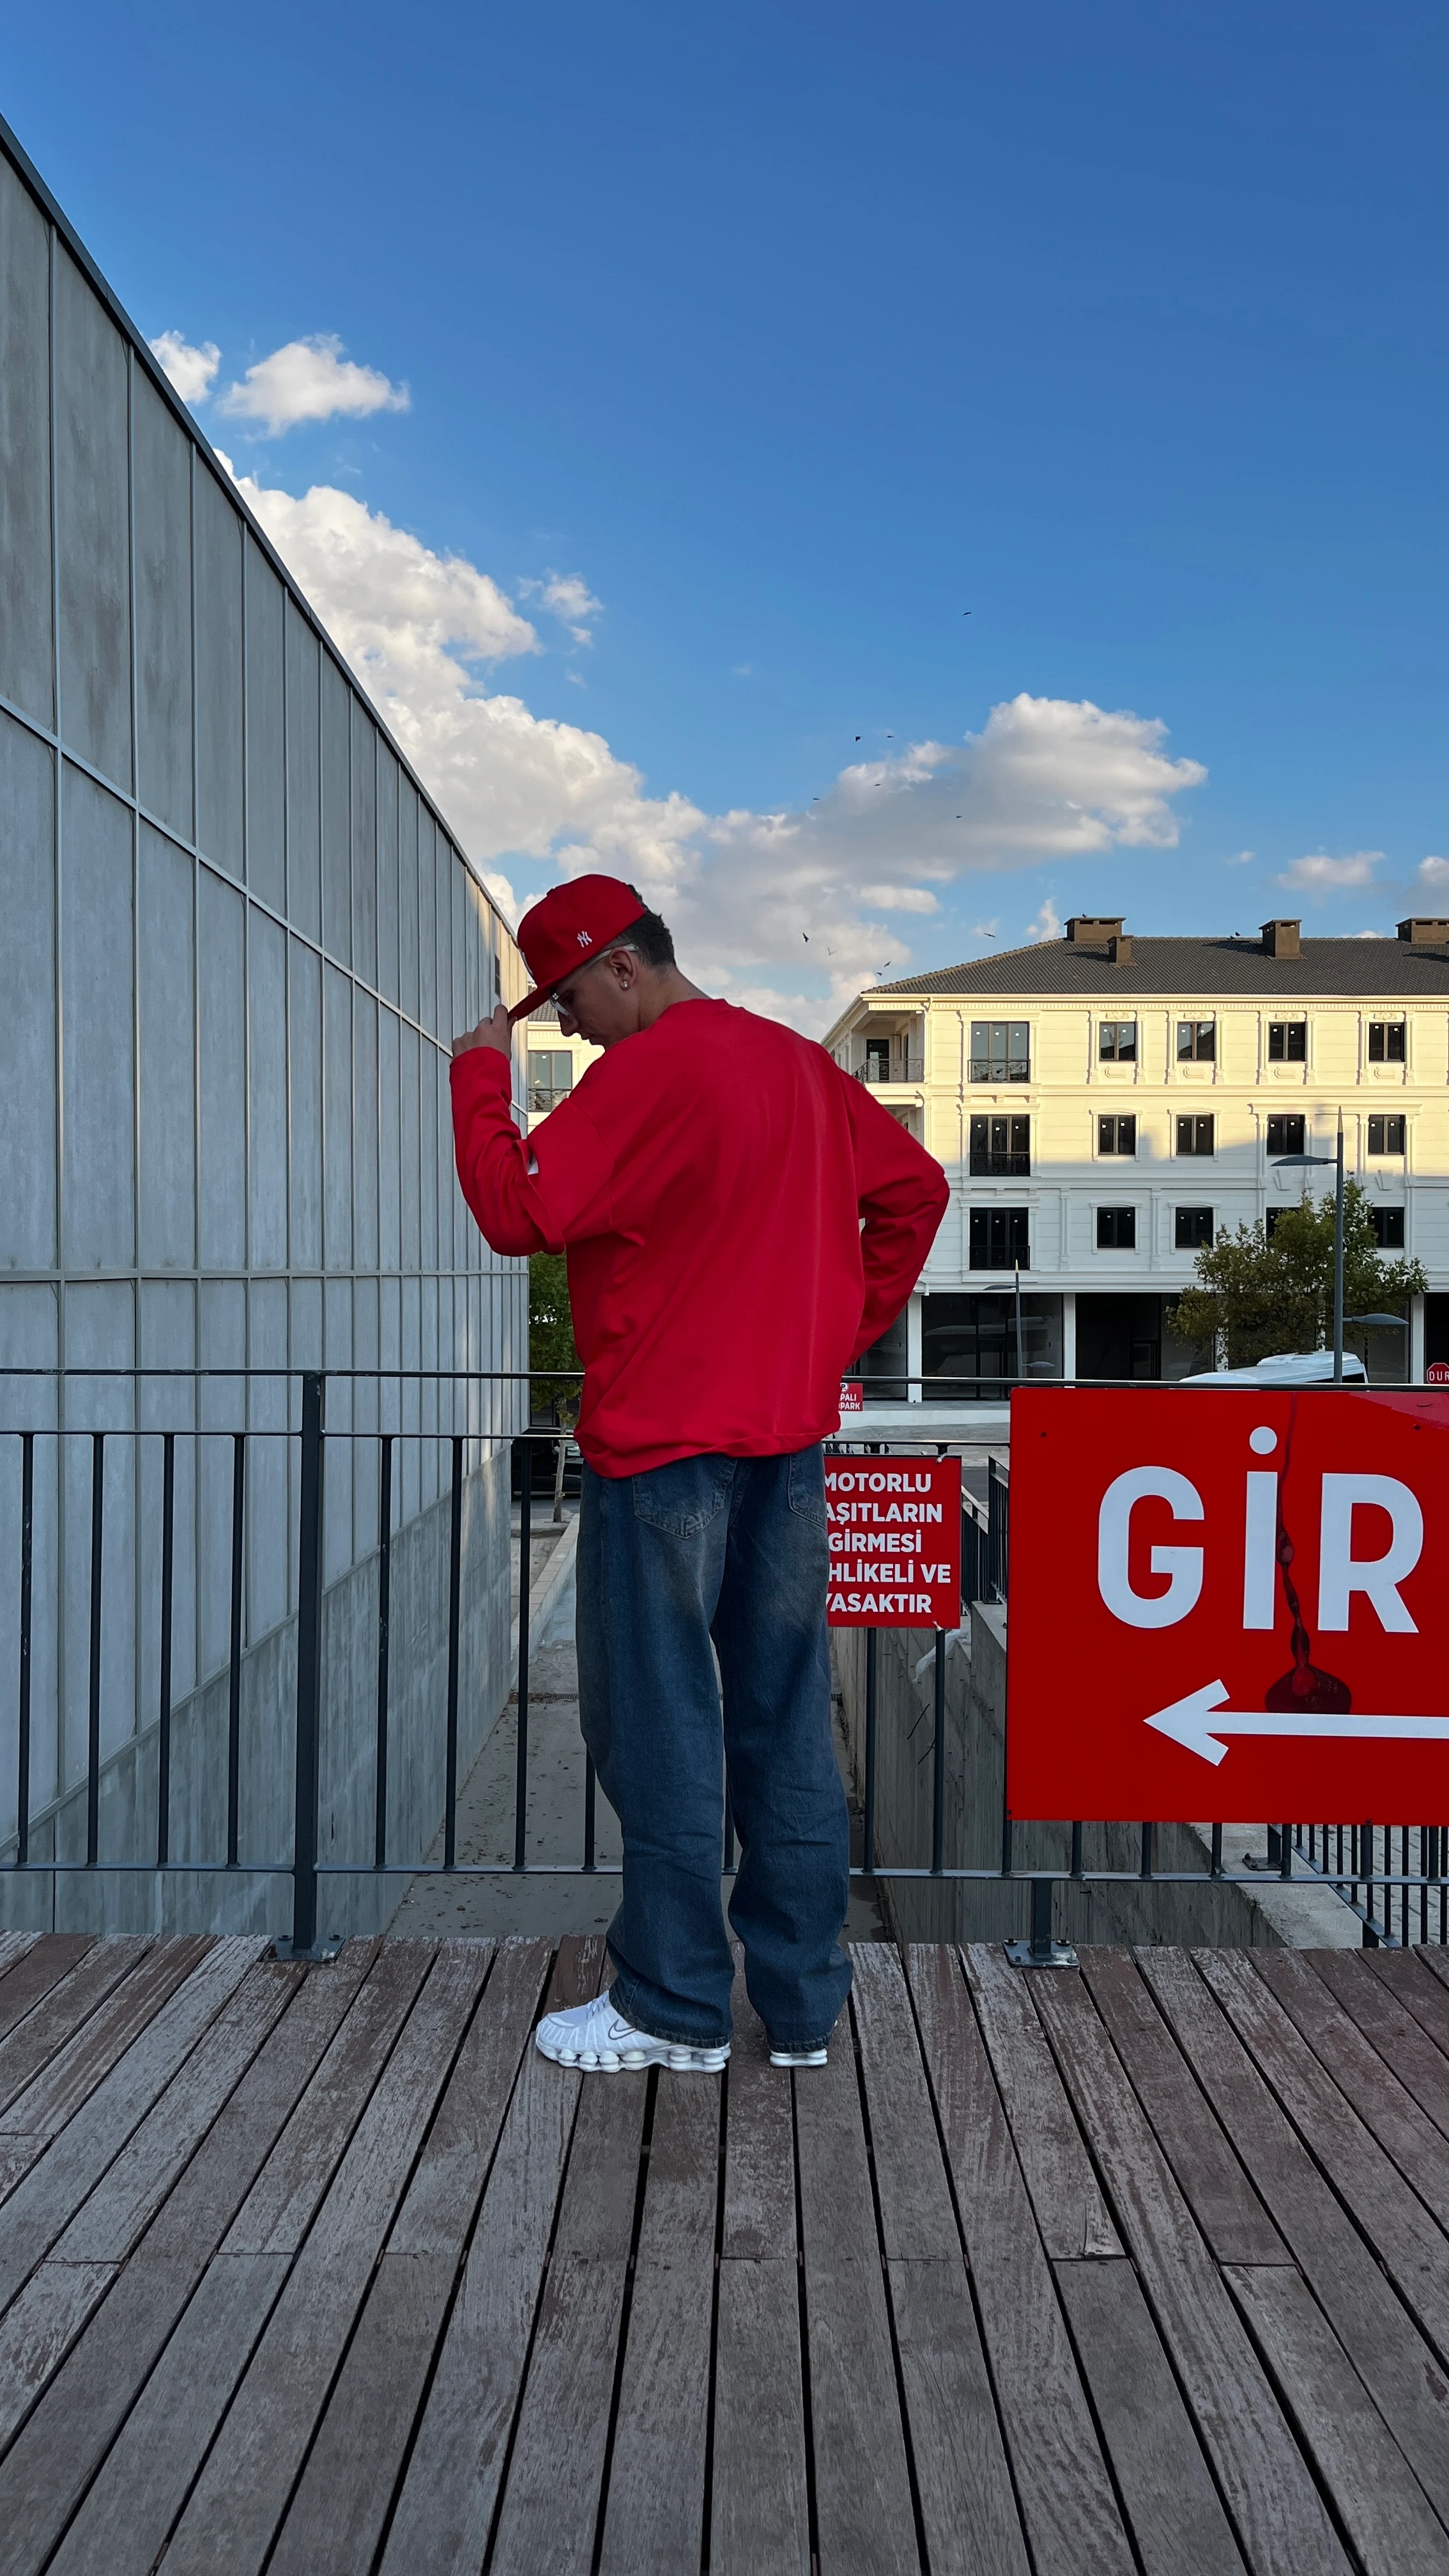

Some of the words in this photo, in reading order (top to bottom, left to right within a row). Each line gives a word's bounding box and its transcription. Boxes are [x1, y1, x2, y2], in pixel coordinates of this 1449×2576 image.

[1429, 1370, 1449, 1381] DUR
[838, 1402, 861, 1410] PARK
[825, 1472, 931, 1492] MOTORLU
[828, 1528, 922, 1552] GİRMESİ
[1098, 1426, 1423, 1633] GİR
[829, 1559, 914, 1583] HLİKELİ
[920, 1564, 951, 1583] VE
